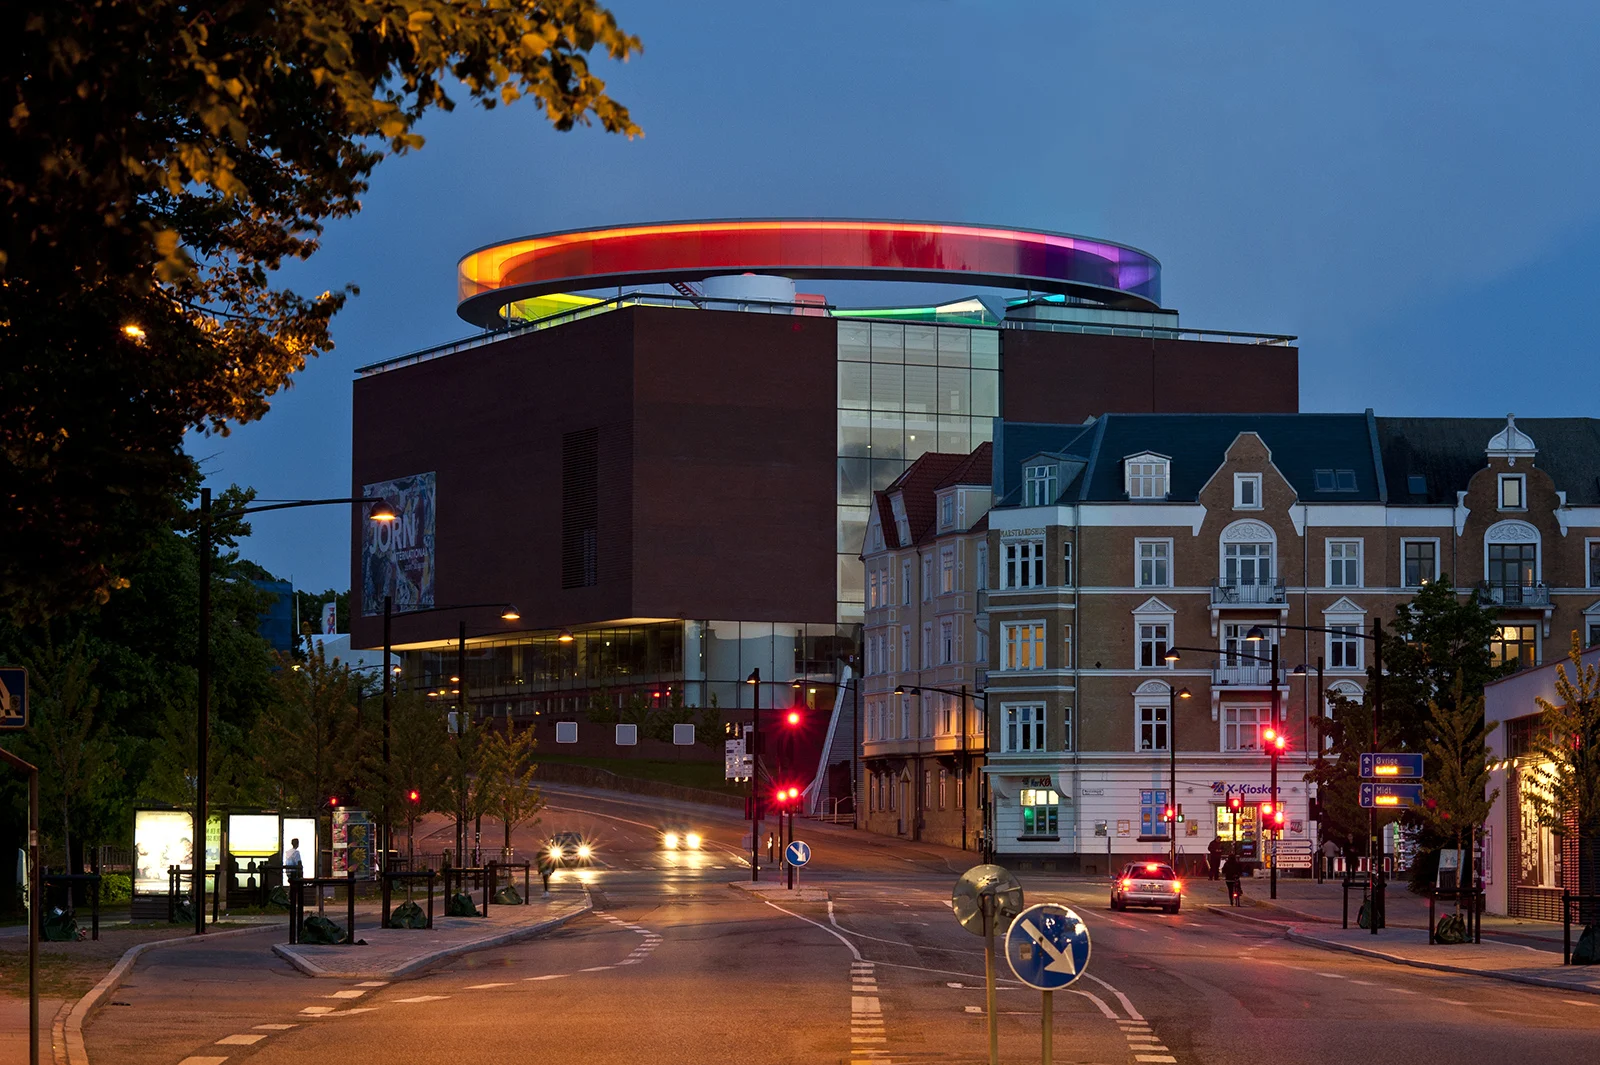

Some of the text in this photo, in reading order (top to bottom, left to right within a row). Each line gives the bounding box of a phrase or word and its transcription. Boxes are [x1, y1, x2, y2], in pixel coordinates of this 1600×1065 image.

[370, 514, 415, 554] JORN
[1376, 756, 1398, 765] Øvrige
[1376, 786, 1391, 795] Midt
